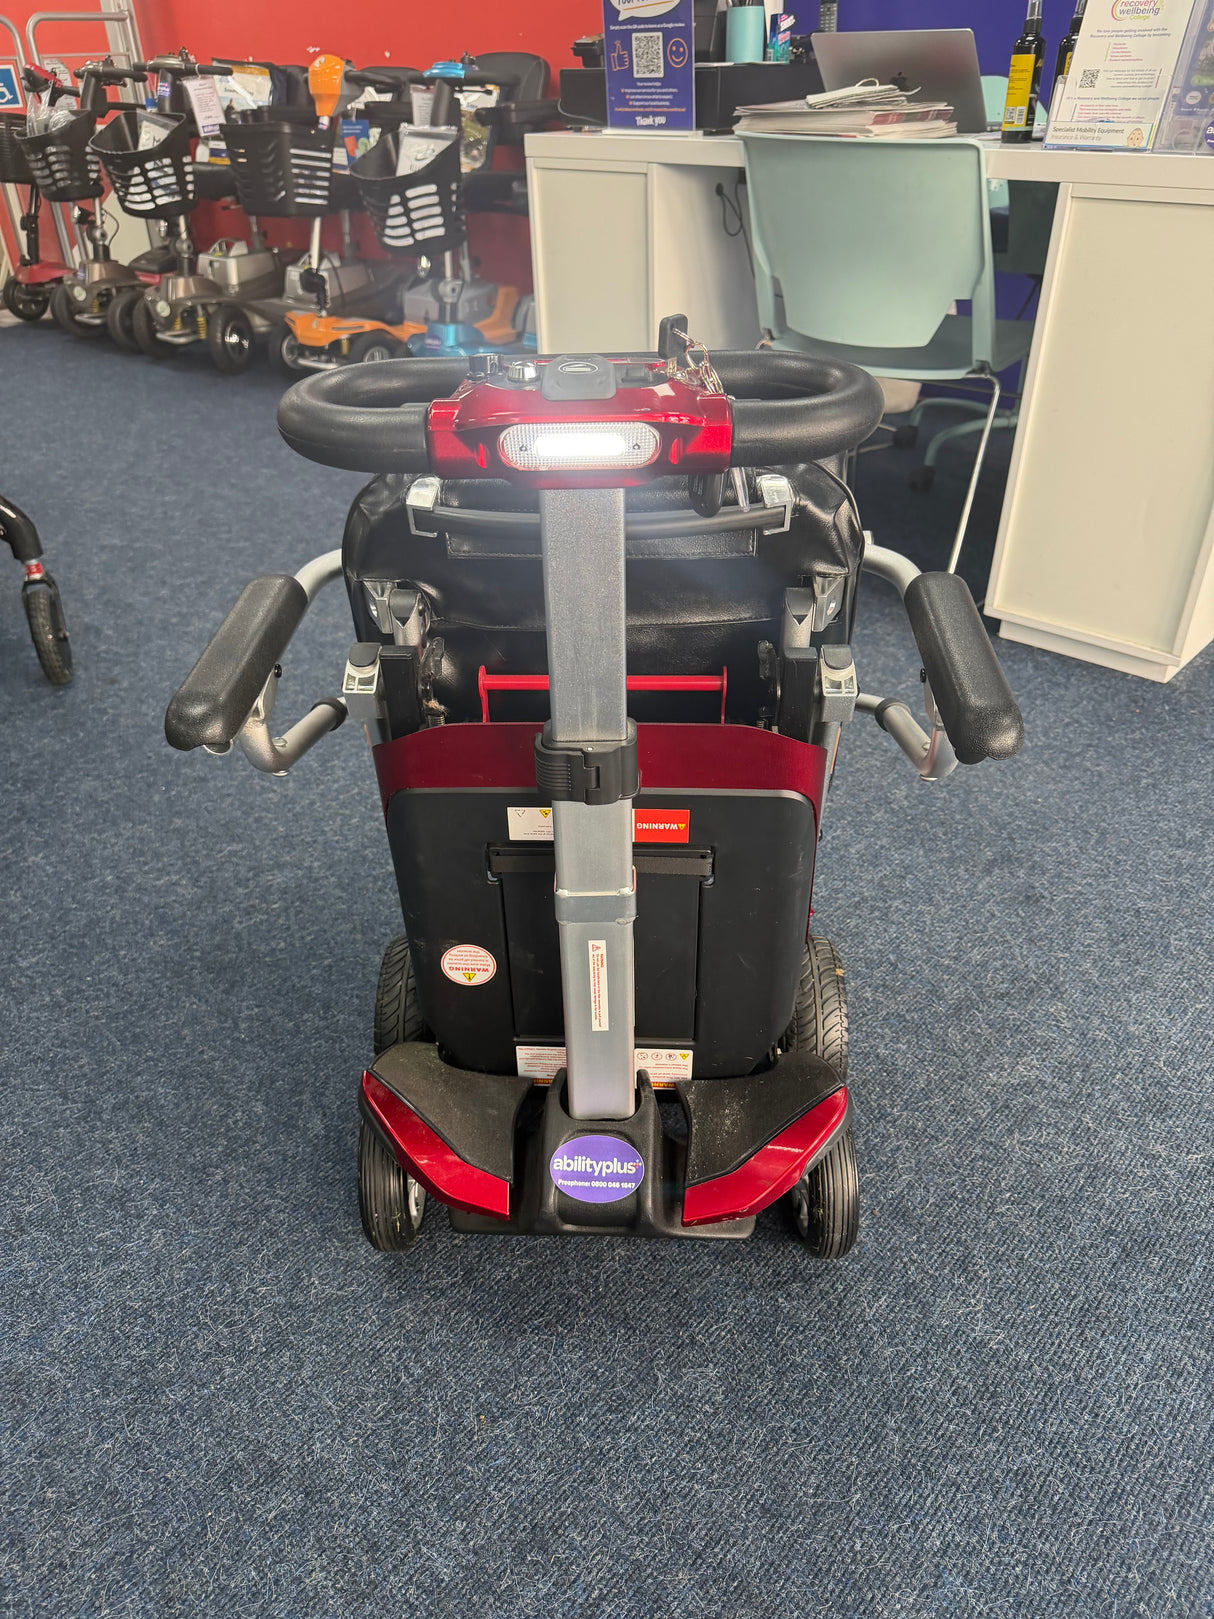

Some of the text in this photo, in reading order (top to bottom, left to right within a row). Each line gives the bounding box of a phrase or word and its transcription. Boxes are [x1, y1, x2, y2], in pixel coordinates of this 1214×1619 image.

[1120, 0, 1158, 8] recovery
[1119, 6, 1160, 15] wellbeing
[635, 116, 666, 126] Thank you
[637, 822, 678, 830] WARNING
[553, 1155, 636, 1177] abilityplus
